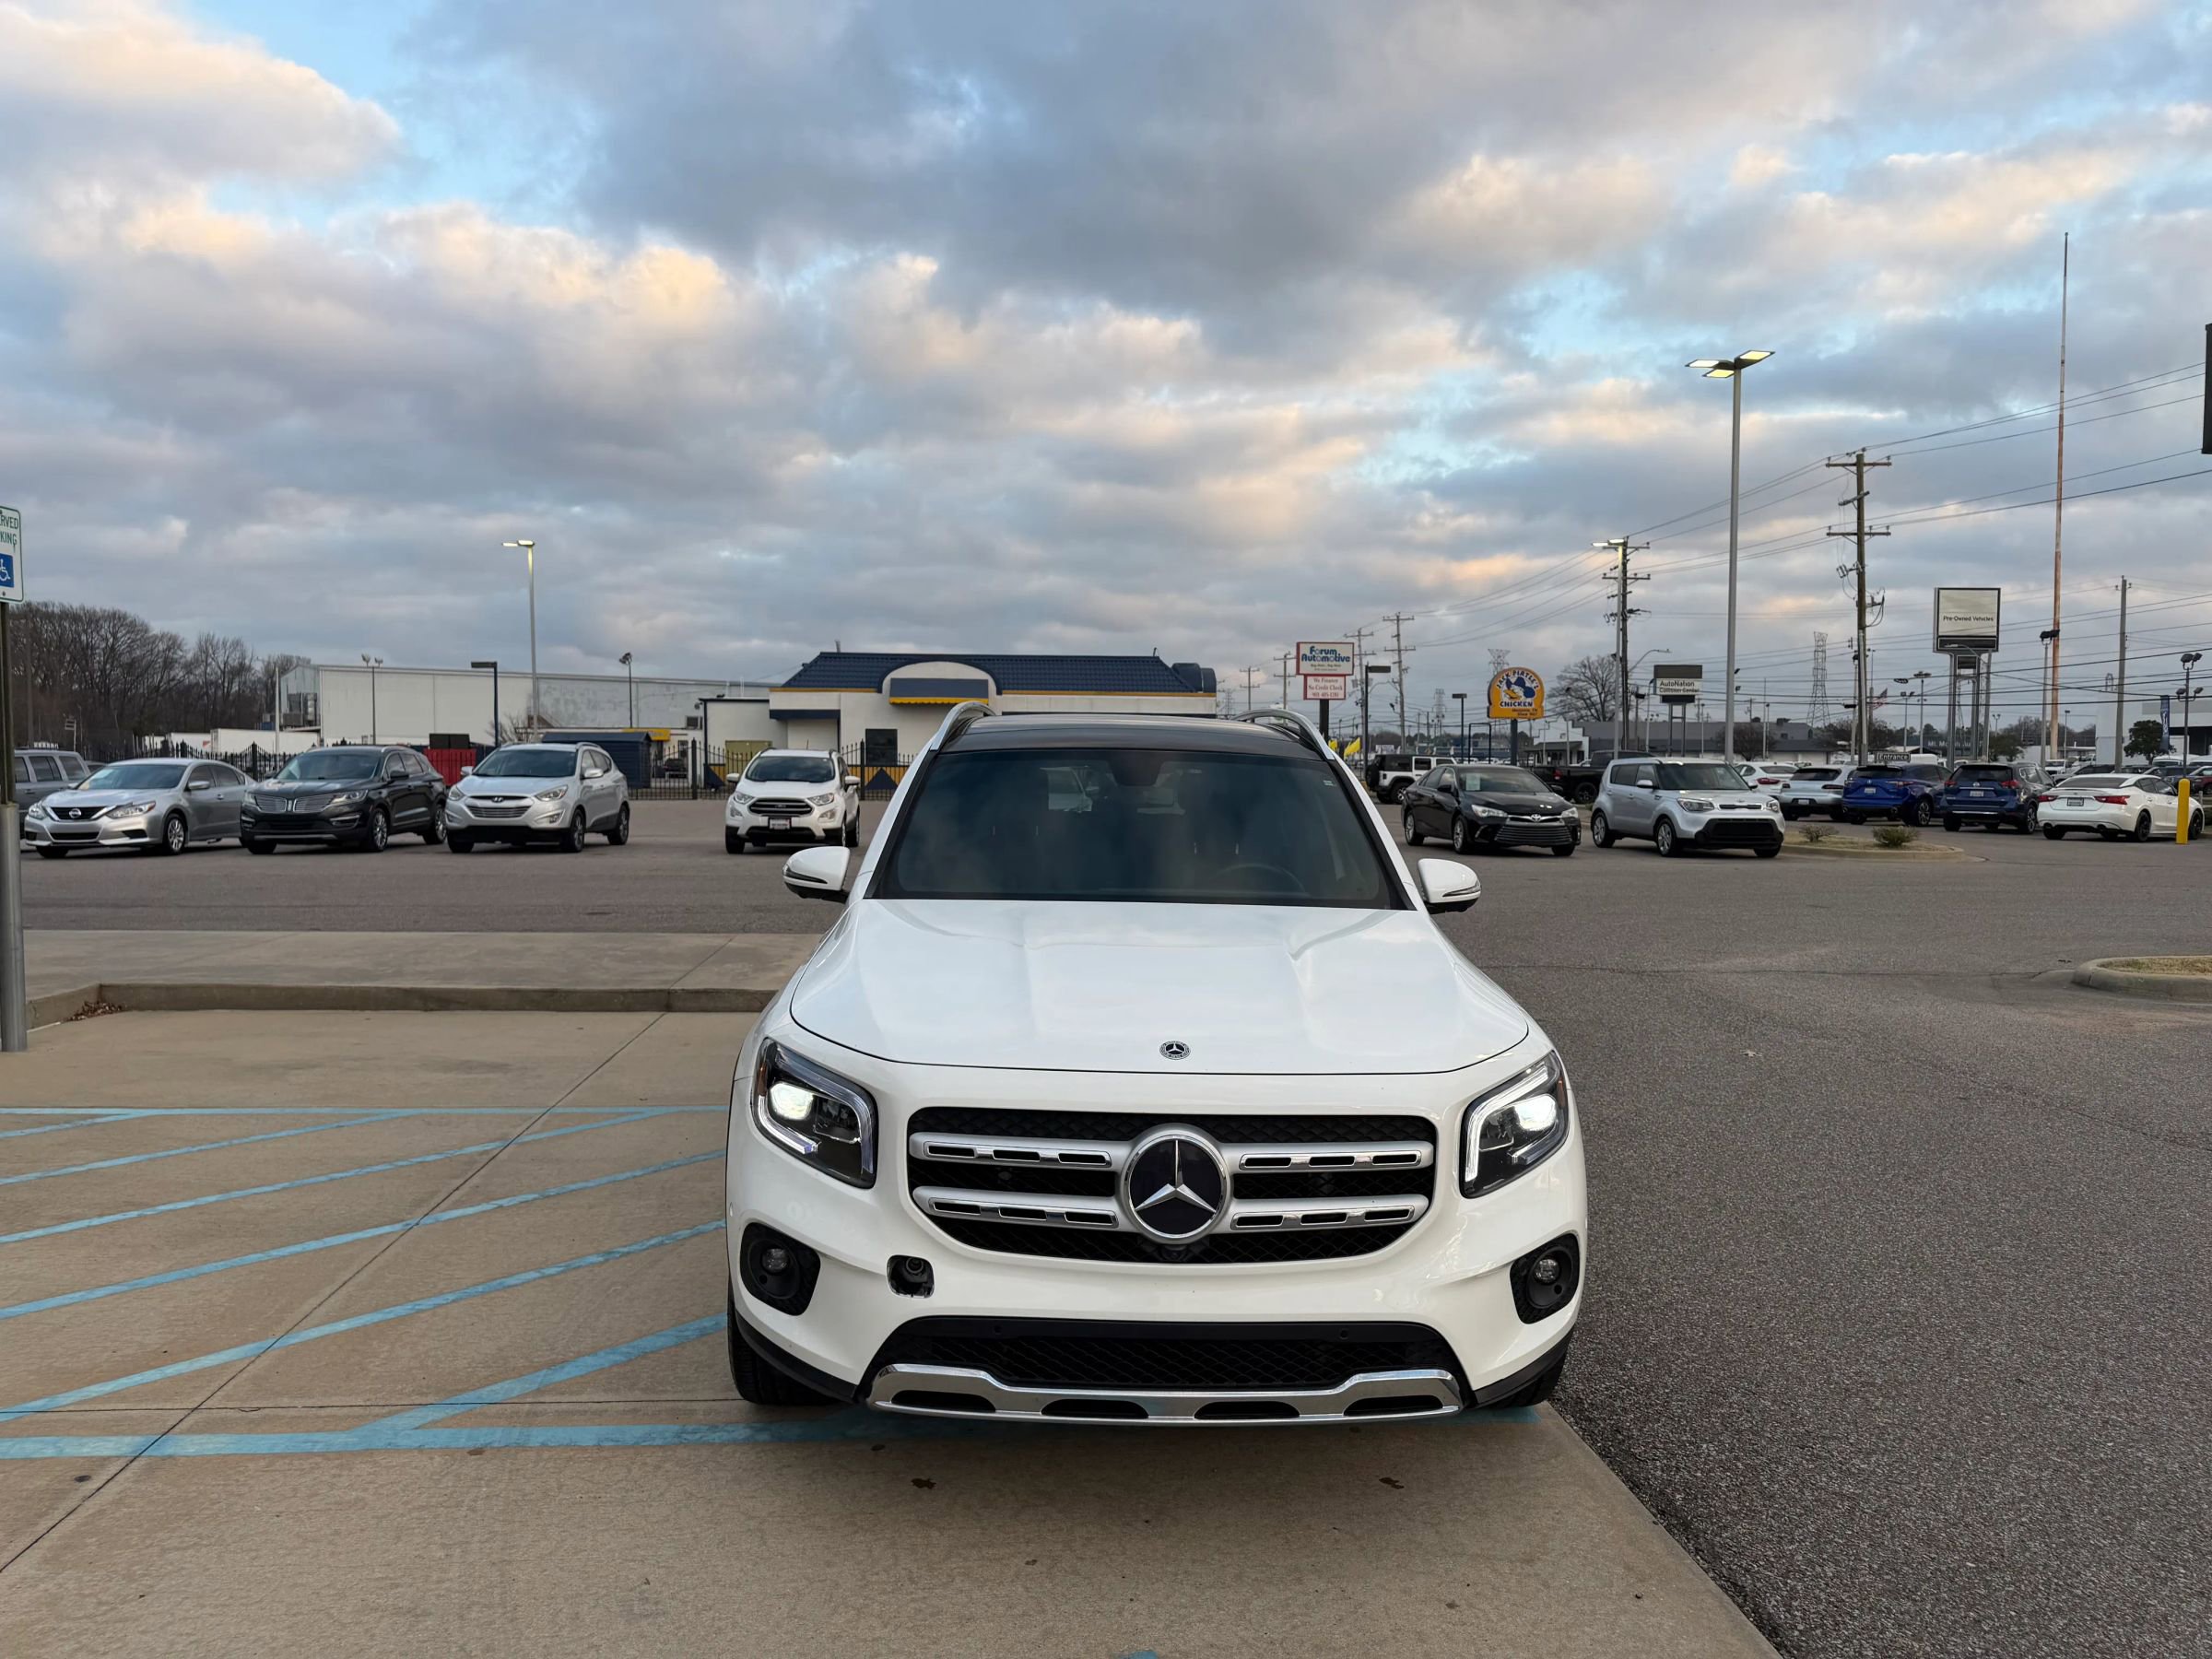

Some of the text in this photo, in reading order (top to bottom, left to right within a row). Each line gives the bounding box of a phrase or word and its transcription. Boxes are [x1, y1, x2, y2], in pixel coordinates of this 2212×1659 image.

[0, 514, 18, 529] RVED
[1310, 646, 1336, 654] Forum
[1301, 653, 1350, 662] Automotive
